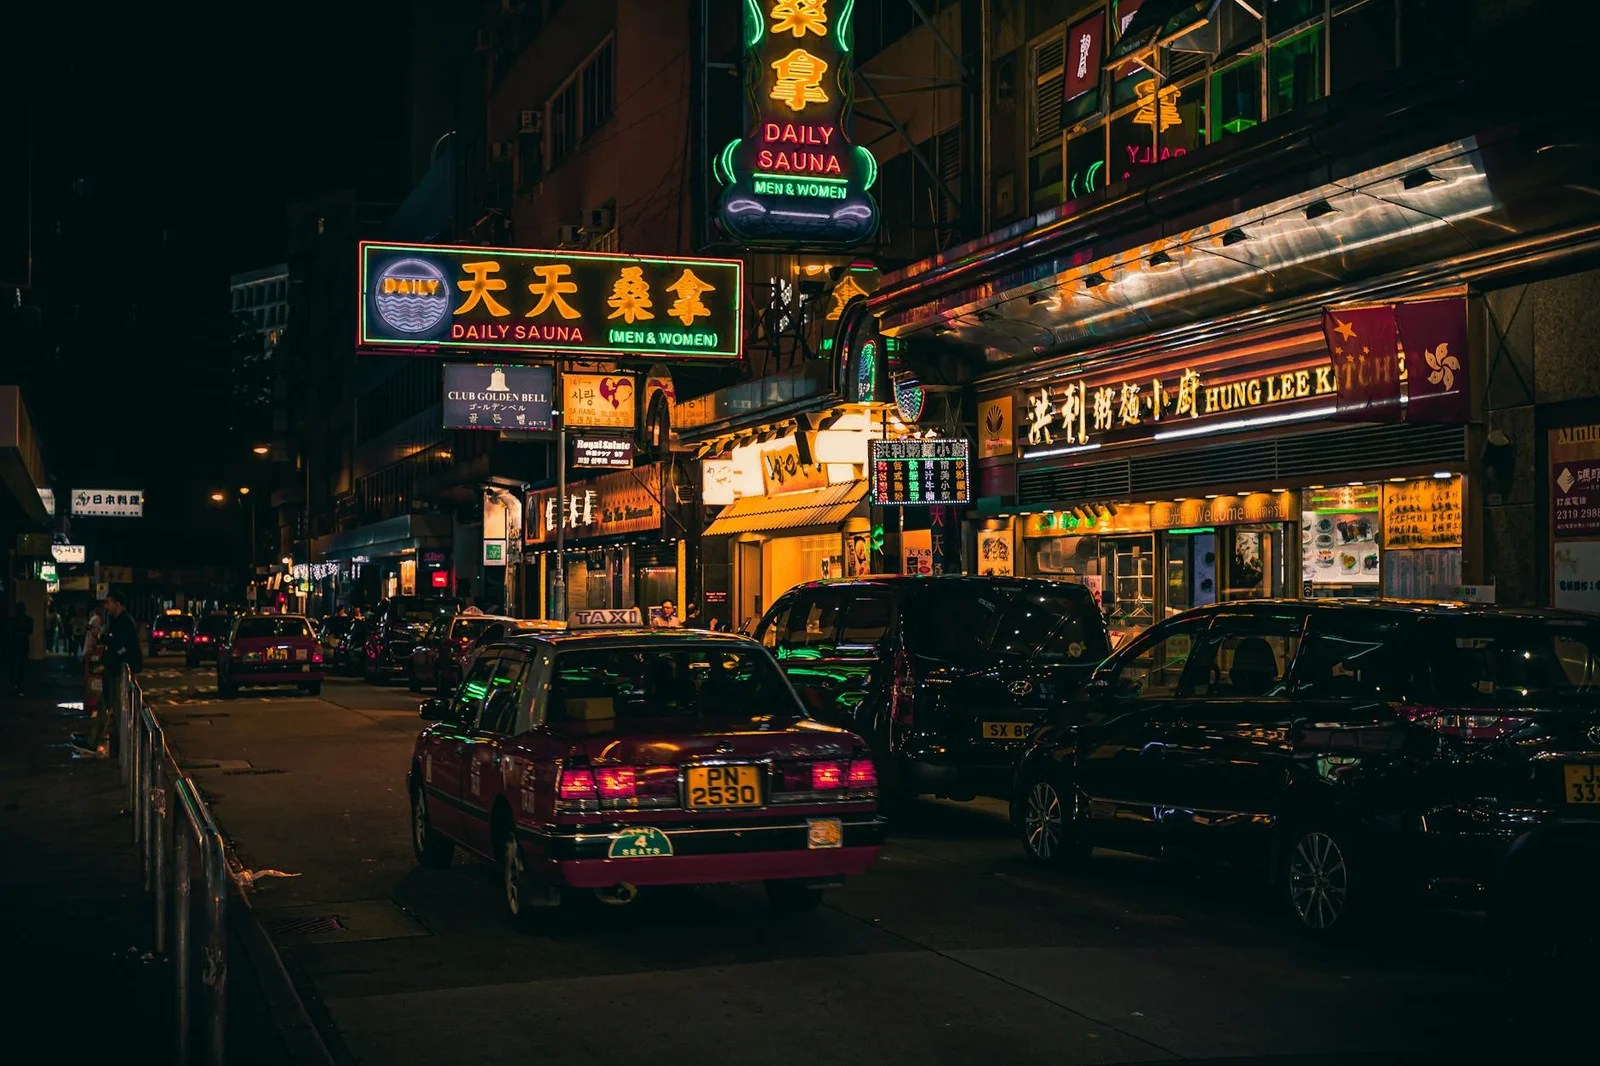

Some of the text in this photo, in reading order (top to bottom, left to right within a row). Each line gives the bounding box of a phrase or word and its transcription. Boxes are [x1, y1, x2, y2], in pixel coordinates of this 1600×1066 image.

[764, 123, 833, 145] DAILY
[757, 150, 841, 174] SAUNA
[754, 181, 847, 199] MEN & WOMEN
[384, 277, 439, 296] DAILY
[453, 261, 716, 326] 天天桑拿
[452, 324, 583, 341] DAILY SAUNA
[608, 329, 718, 347] (MEN & WOMEN)
[1205, 352, 1416, 413] HUNG LEE KITCHE
[448, 391, 547, 403] CLUB GOLDEN BELL
[571, 388, 596, 406] 사랑
[469, 403, 526, 412] ゴールデンベル
[93, 494, 140, 505] 日本料理
[1196, 504, 1244, 522] Welcome
[1557, 510, 1578, 520] 2319
[575, 611, 638, 625] TAXI
[990, 724, 1007, 736] SX
[708, 768, 739, 786] PN
[1583, 766, 1600, 783] J
[692, 786, 755, 806] 2530
[1572, 784, 1600, 802] 33
[634, 835, 647, 848] 4
[622, 848, 660, 856] SEATS
